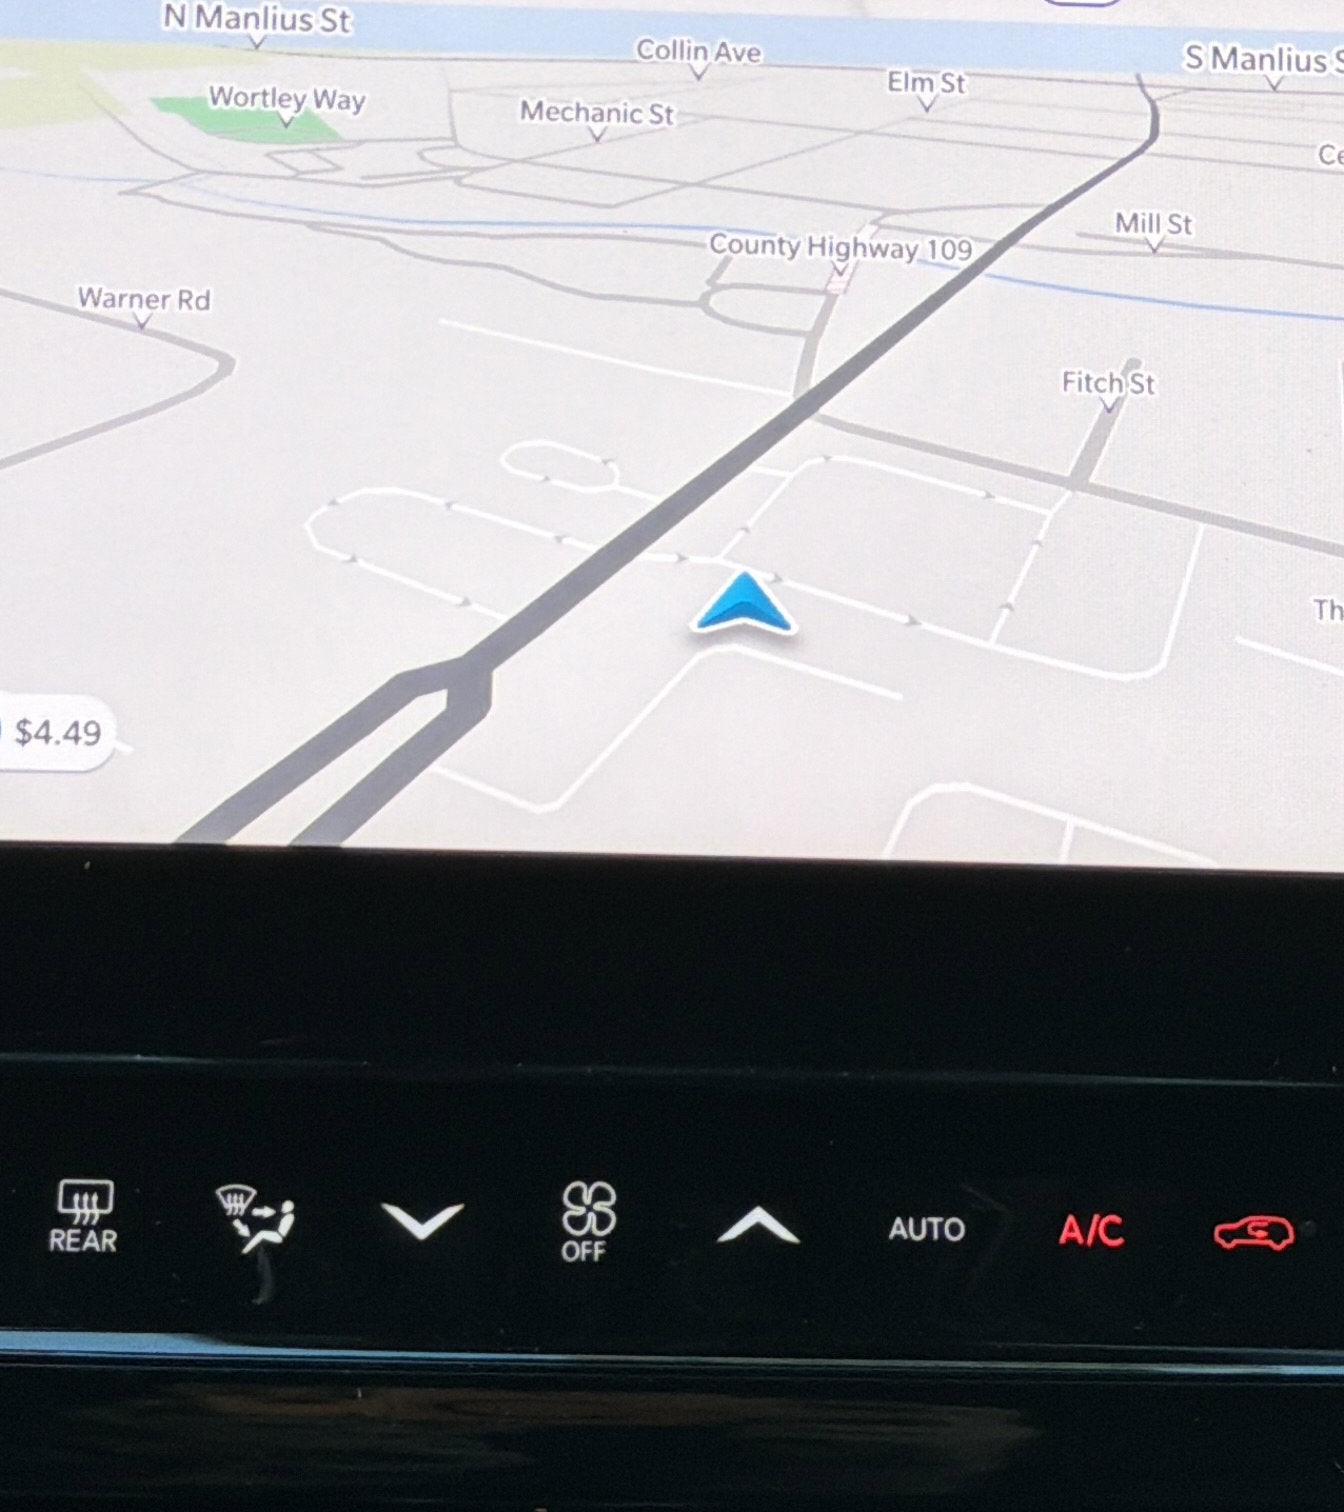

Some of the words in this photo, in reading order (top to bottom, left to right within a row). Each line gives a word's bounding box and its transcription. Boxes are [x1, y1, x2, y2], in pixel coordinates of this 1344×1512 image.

[164, 4, 185, 29] N
[195, 6, 310, 33] Manlius
[319, 8, 351, 34] St
[636, 39, 707, 62] Collin
[714, 41, 761, 64] Ave
[1186, 45, 1204, 70] S
[1211, 47, 1328, 73] Manlius
[888, 71, 935, 94] Elm
[942, 73, 966, 94] St
[208, 84, 305, 112] Wortley
[313, 89, 366, 115] Way
[520, 99, 642, 124] Mechanic
[648, 104, 674, 126] St
[1115, 212, 1160, 234] Mill
[1163, 213, 1192, 235] St
[710, 232, 800, 261] County
[808, 236, 918, 264] Highway
[929, 238, 972, 262] 109
[78, 286, 170, 311] Warner
[178, 289, 211, 312] Rd
[1062, 371, 1124, 394] Fitch
[1130, 373, 1155, 395] St
[15, 717, 102, 747] $4.49
[49, 1228, 117, 1253] REAR
[889, 1216, 965, 1242] AUTO
[1059, 1214, 1124, 1248] A/C
[561, 1242, 607, 1263] OFF
